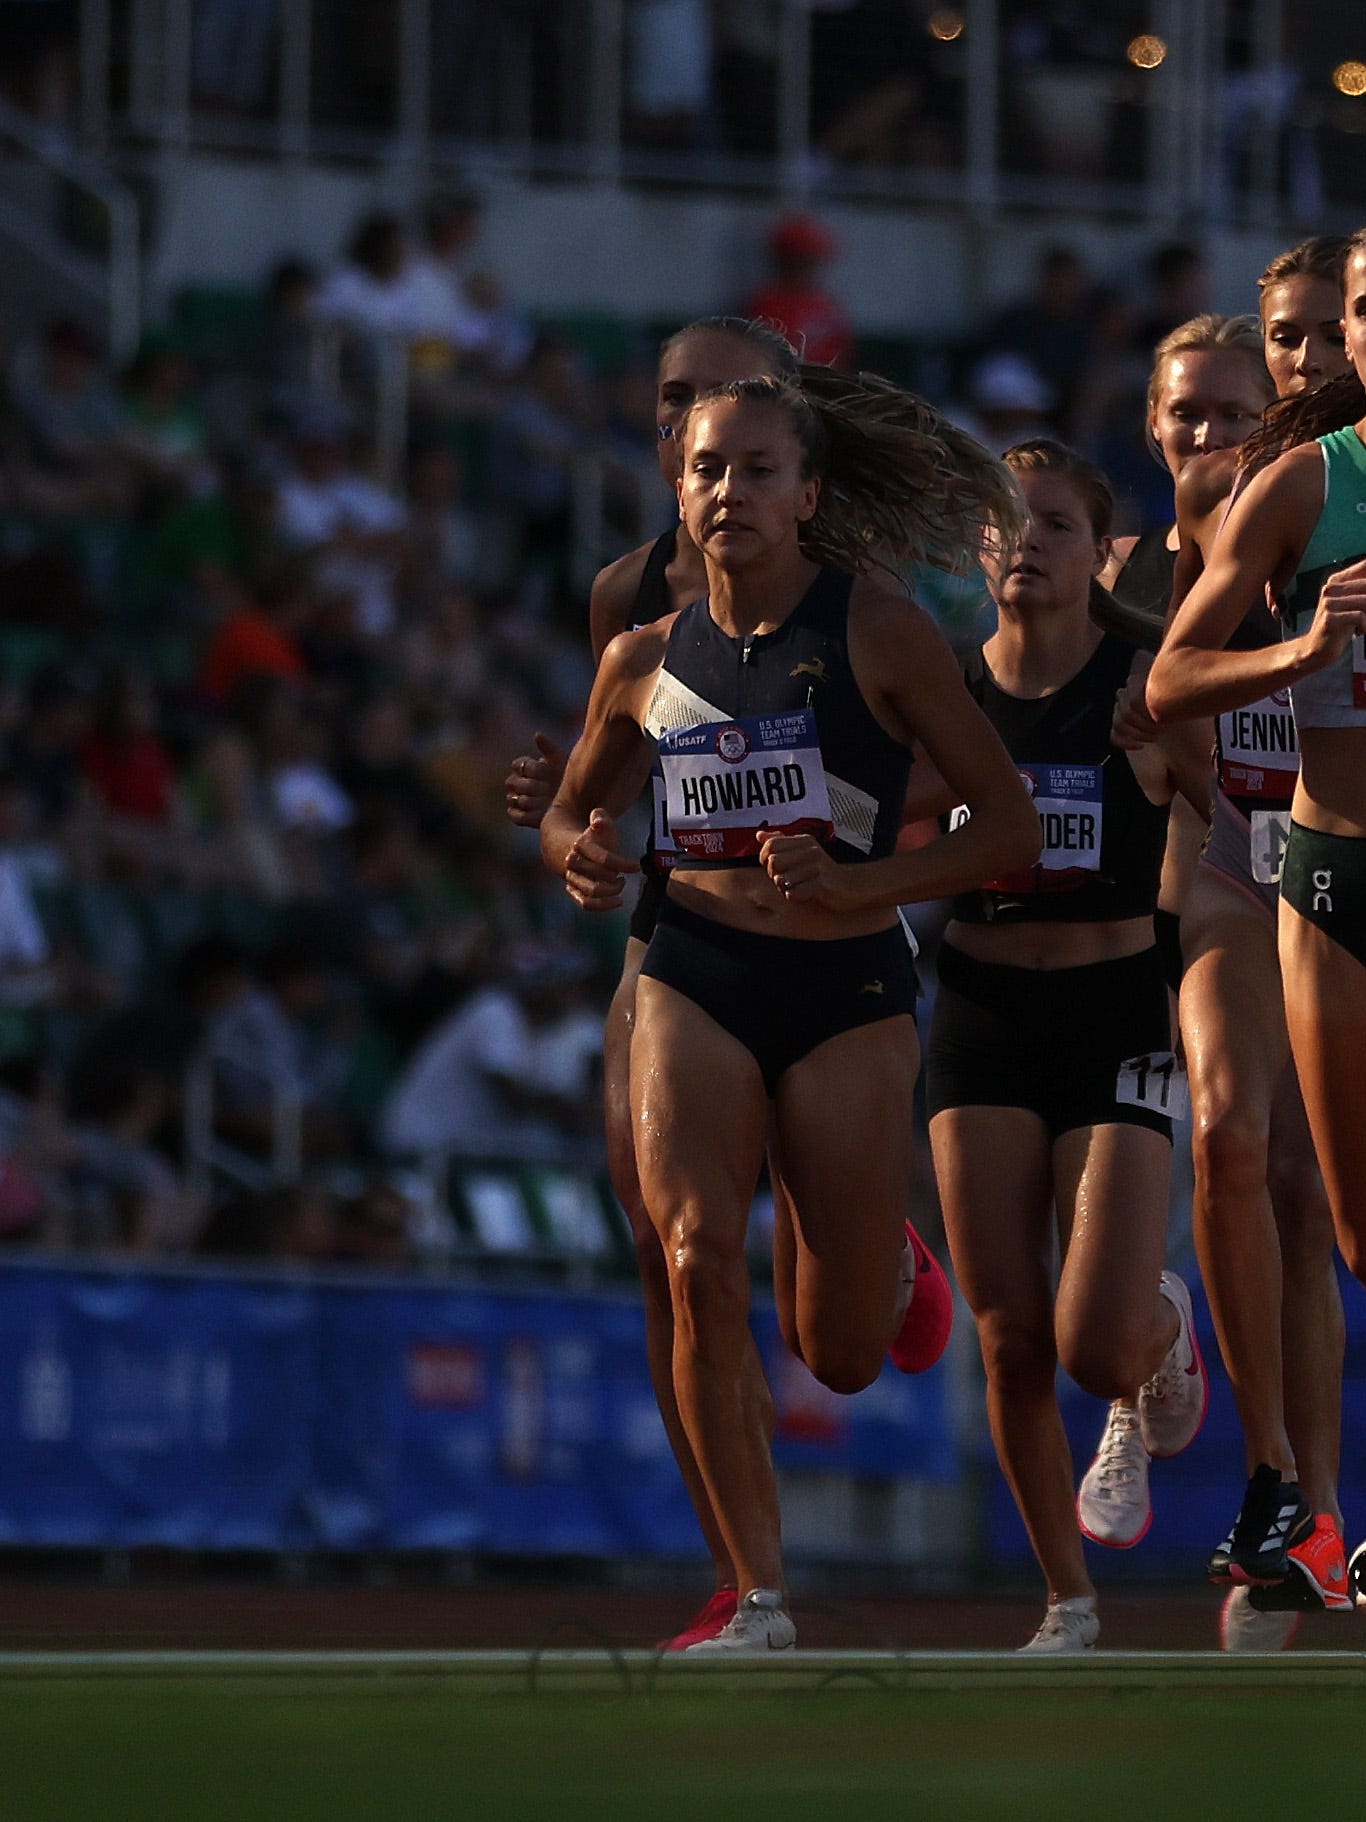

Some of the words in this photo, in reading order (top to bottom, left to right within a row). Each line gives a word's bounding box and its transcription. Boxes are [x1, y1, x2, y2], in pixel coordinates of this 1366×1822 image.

[775, 715, 805, 728] OLYMPIC
[760, 729, 780, 740] TEAM
[781, 726, 807, 737] TRIALS
[680, 735, 707, 748] USATF
[1065, 770, 1095, 780] OLYMPIC
[682, 764, 806, 816] HOWARD
[1050, 779, 1070, 788] TEAM
